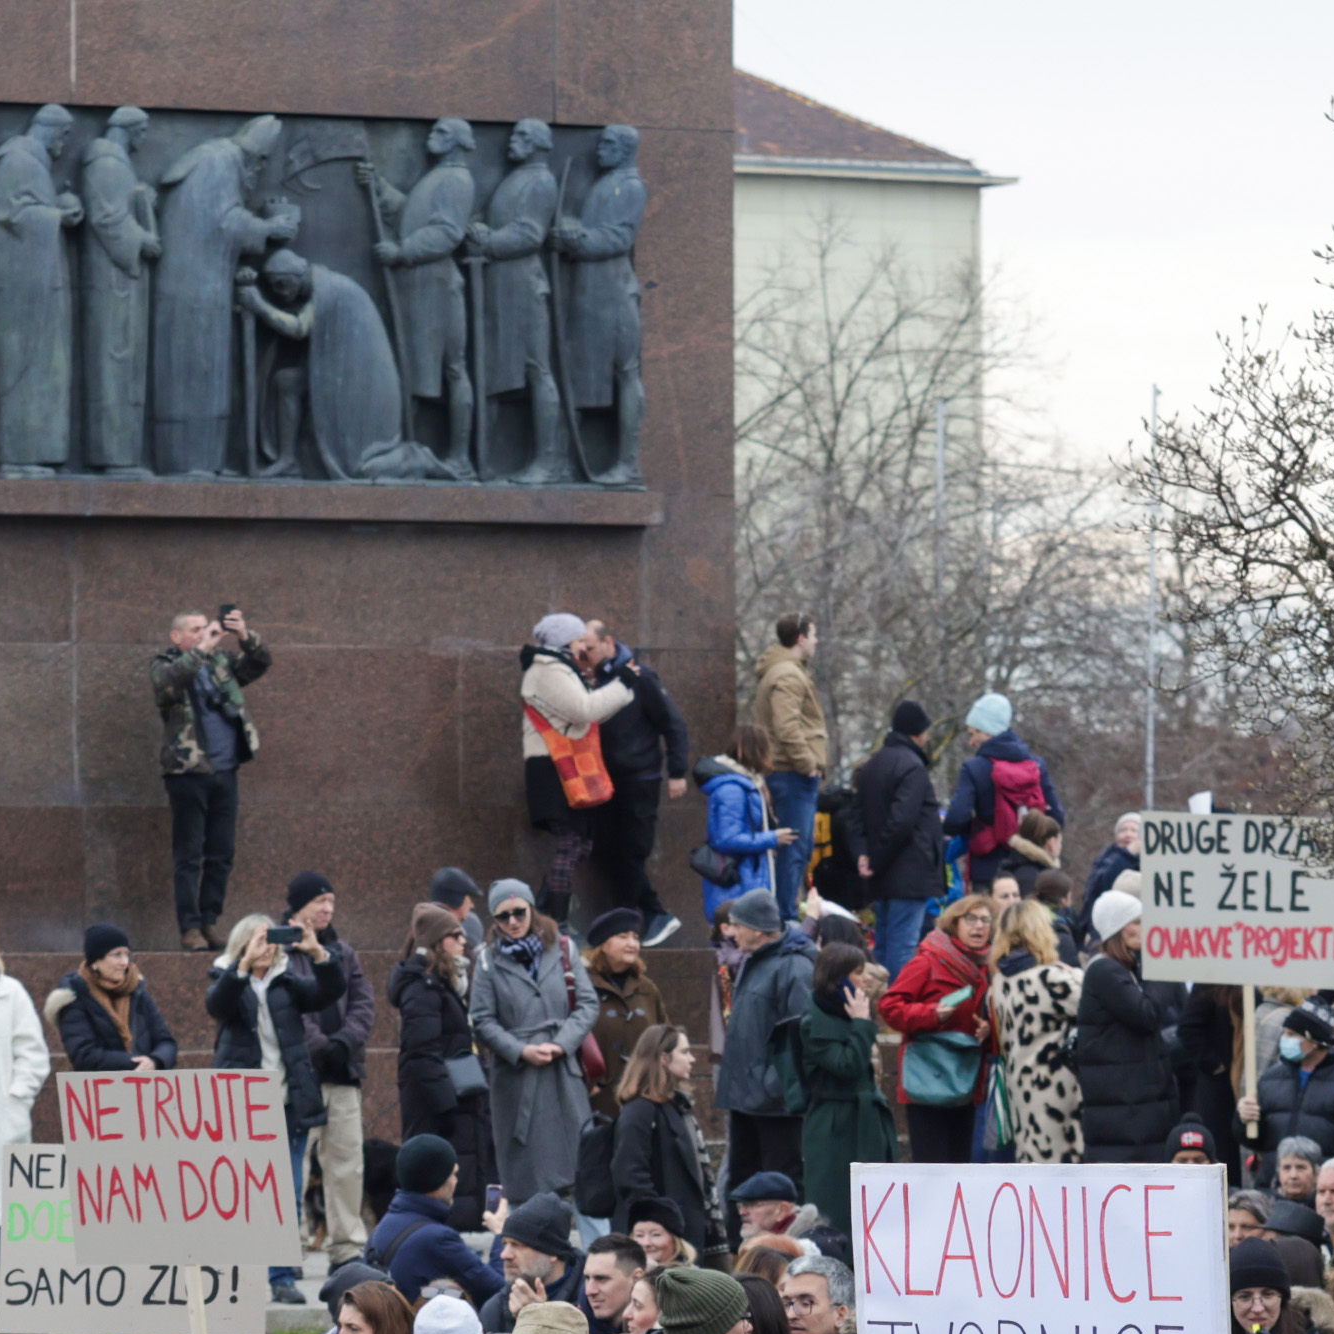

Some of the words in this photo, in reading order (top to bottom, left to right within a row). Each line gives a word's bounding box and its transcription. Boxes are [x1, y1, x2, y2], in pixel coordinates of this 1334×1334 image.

[1144, 819, 1233, 855] DRUGE
[1154, 871, 1195, 908] NE
[1218, 863, 1310, 912] ŽELE
[1146, 925, 1233, 959] OVAKVE
[65, 1078, 124, 1142] NE
[122, 1073, 278, 1142] TRUJTE
[77, 1162, 167, 1226] NAM
[178, 1154, 283, 1226] DOM
[861, 1181, 1183, 1304] KLAONICE
[5, 1265, 126, 1307] SAMO
[142, 1265, 239, 1306] ZLO!
